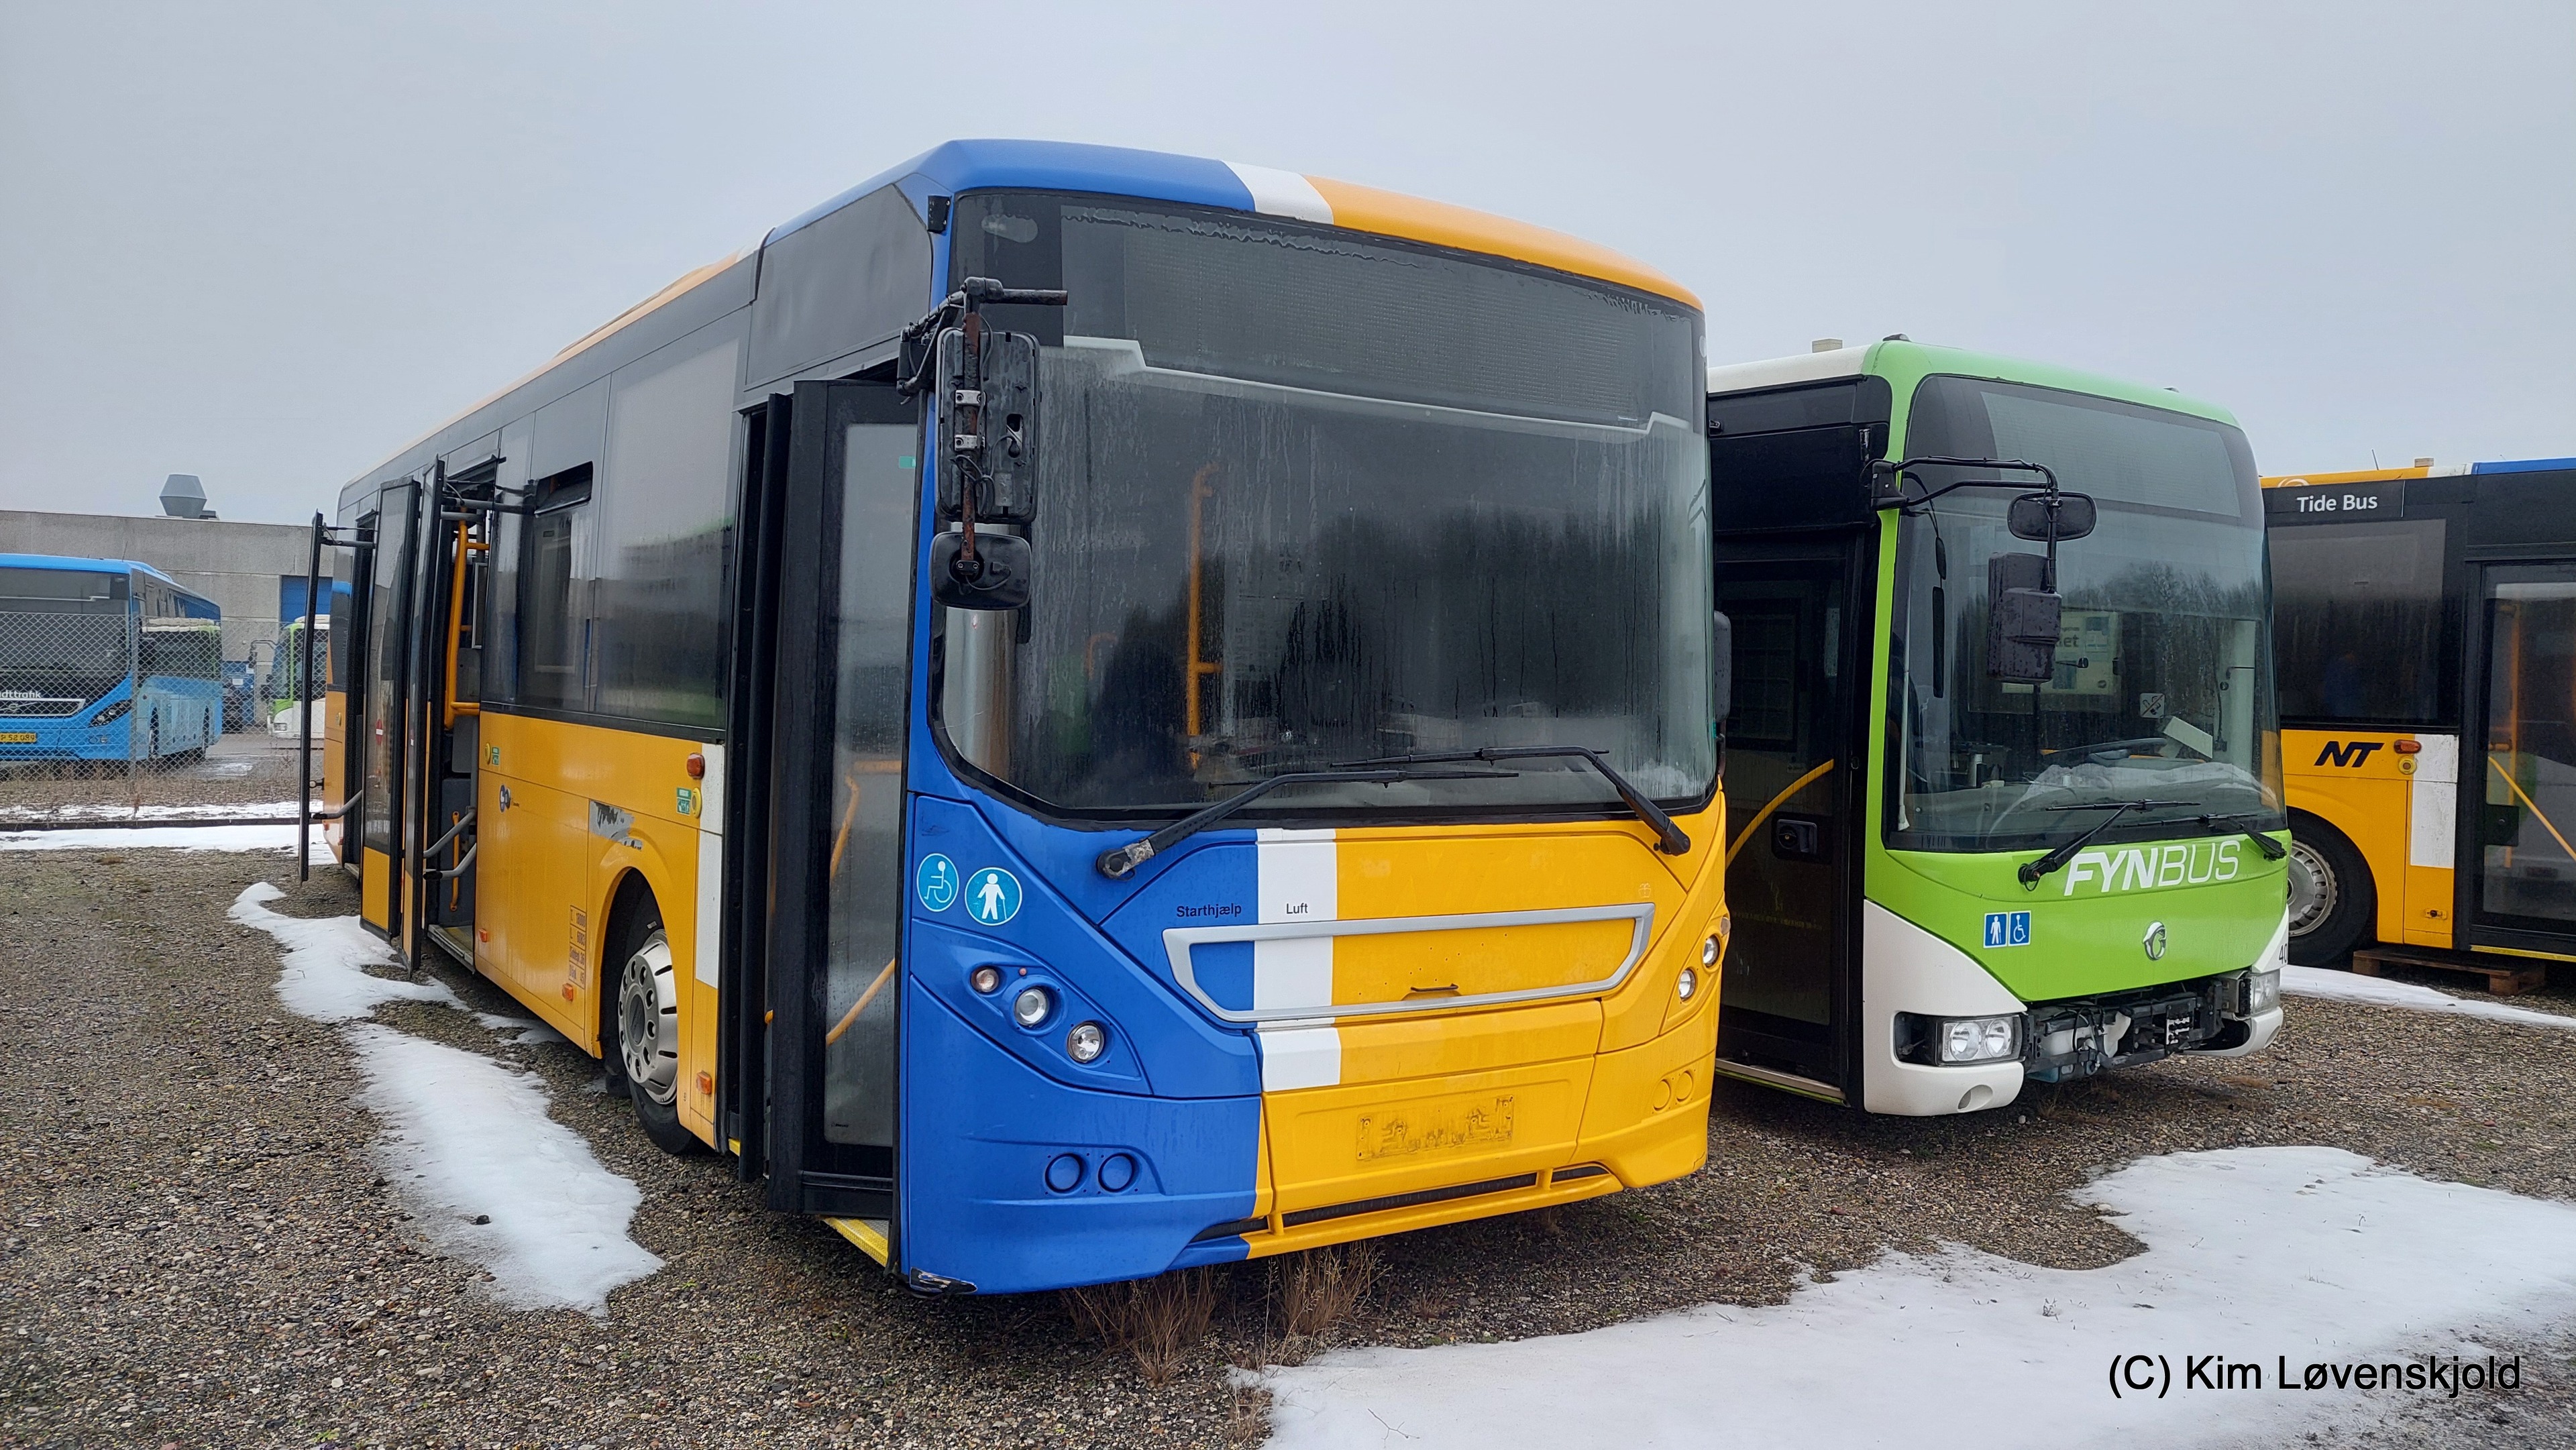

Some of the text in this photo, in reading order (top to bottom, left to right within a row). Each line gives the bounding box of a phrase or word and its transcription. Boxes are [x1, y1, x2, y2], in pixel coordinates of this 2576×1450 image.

[2297, 494, 2377, 512] Tide Bus
[0, 689, 41, 698] dttrafik
[2314, 740, 2385, 767] NT
[2063, 840, 2241, 896] FYNBUS
[1176, 903, 1242, 918] Starthjælp
[1286, 903, 1308, 914] Luft
